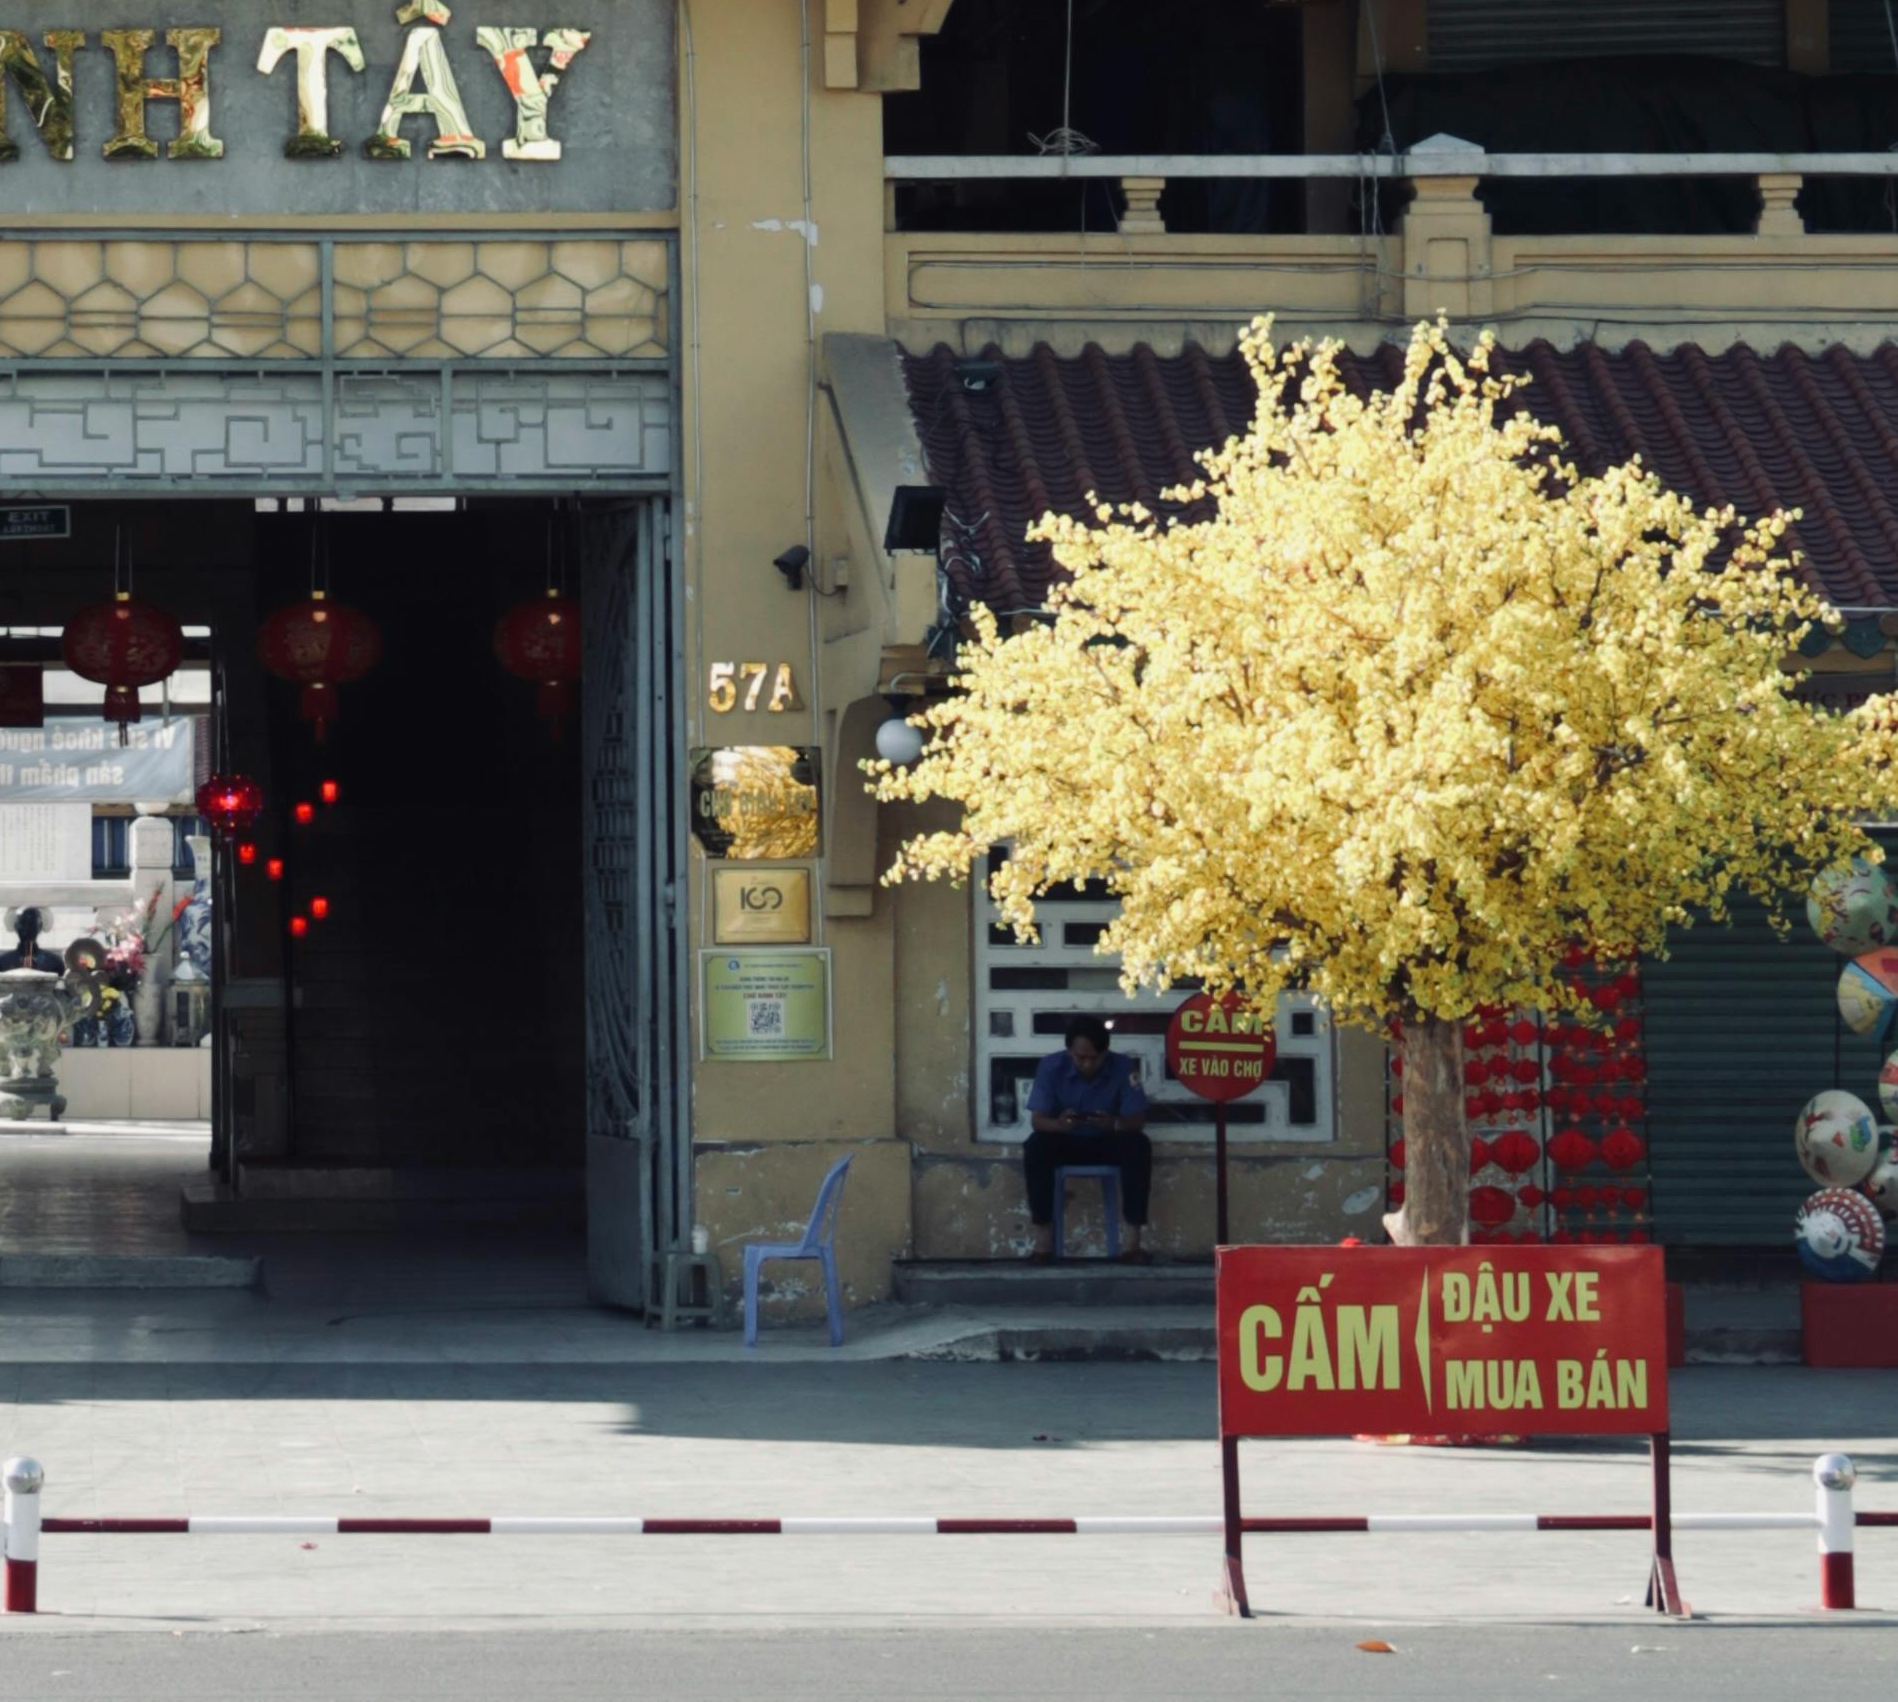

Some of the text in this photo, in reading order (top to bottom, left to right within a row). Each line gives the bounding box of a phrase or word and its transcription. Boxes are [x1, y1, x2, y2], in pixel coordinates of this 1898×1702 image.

[709, 661, 806, 713] 57A
[1179, 1055, 1263, 1082] XE VÀO CHỢ
[1441, 1261, 1601, 1334] ĐẬU XE
[1238, 1272, 1401, 1393] CẤM
[1445, 1348, 1648, 1410] MUA BÁN
